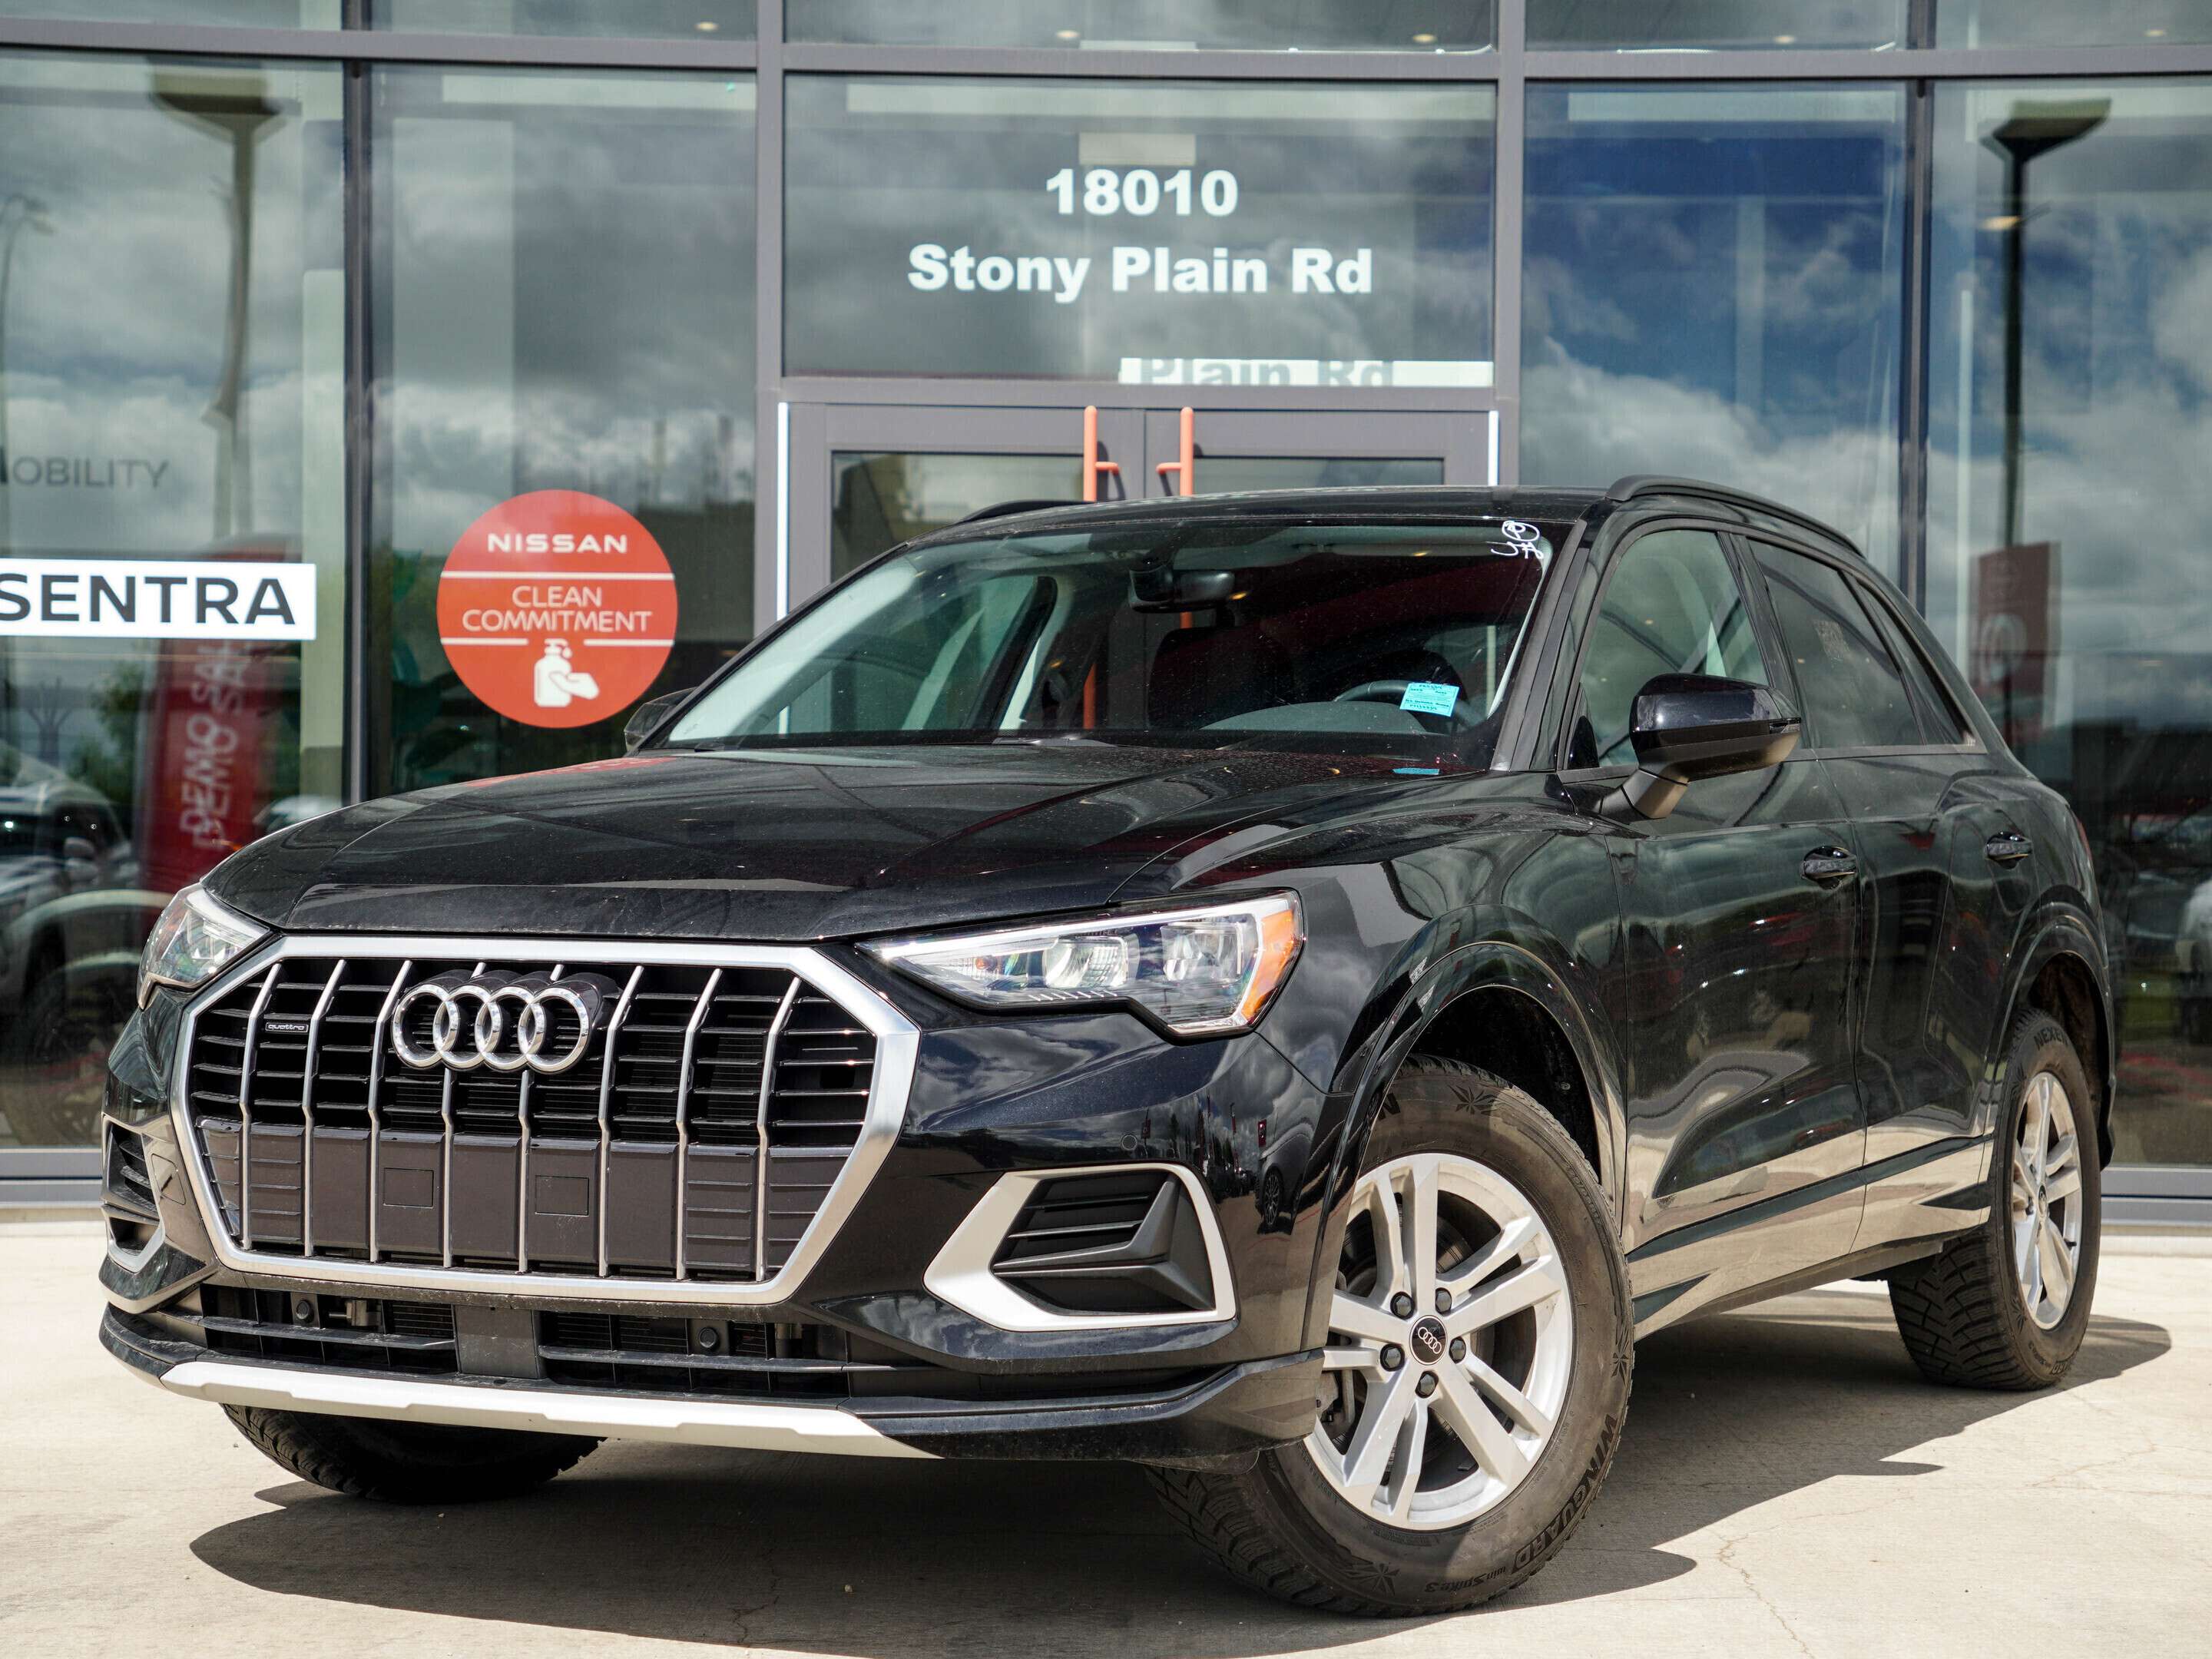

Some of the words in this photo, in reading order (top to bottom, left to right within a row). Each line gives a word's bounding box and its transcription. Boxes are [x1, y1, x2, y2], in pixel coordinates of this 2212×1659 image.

[1046, 168, 1239, 217] 18010
[908, 243, 1091, 304] Stony
[1111, 246, 1268, 294] Plain
[1291, 247, 1373, 294] Rd
[0, 455, 170, 488] OBILITY
[487, 533, 628, 554] NISSAN
[0, 573, 296, 625] SENTRA
[512, 585, 603, 608] CLEAN
[462, 609, 652, 632] COMMITMENT
[267, 1023, 306, 1031] quattro
[1512, 1413, 1618, 1573] WINGUARD
